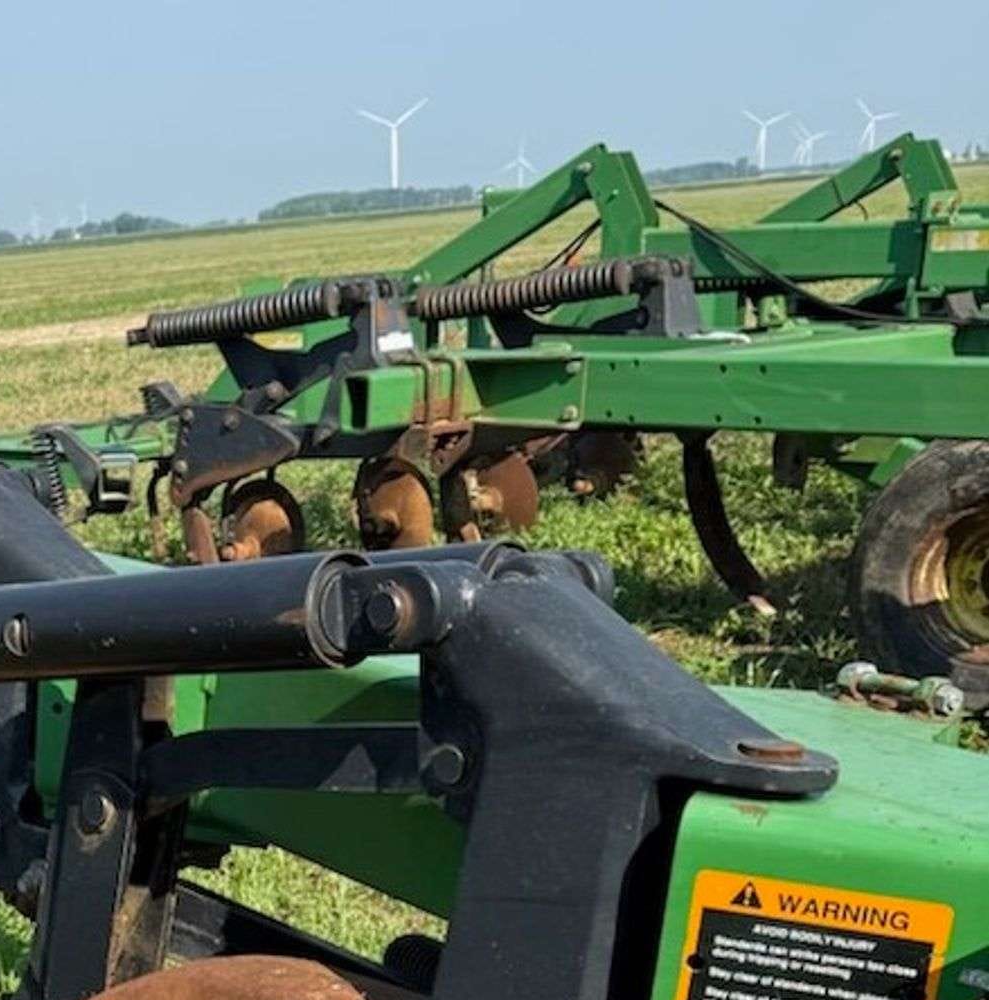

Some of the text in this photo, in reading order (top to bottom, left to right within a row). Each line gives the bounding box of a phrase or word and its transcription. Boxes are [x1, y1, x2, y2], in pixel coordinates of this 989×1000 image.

[778, 893, 910, 931] WARNING
[709, 966, 732, 981] Stay
[734, 972, 759, 984] clear
